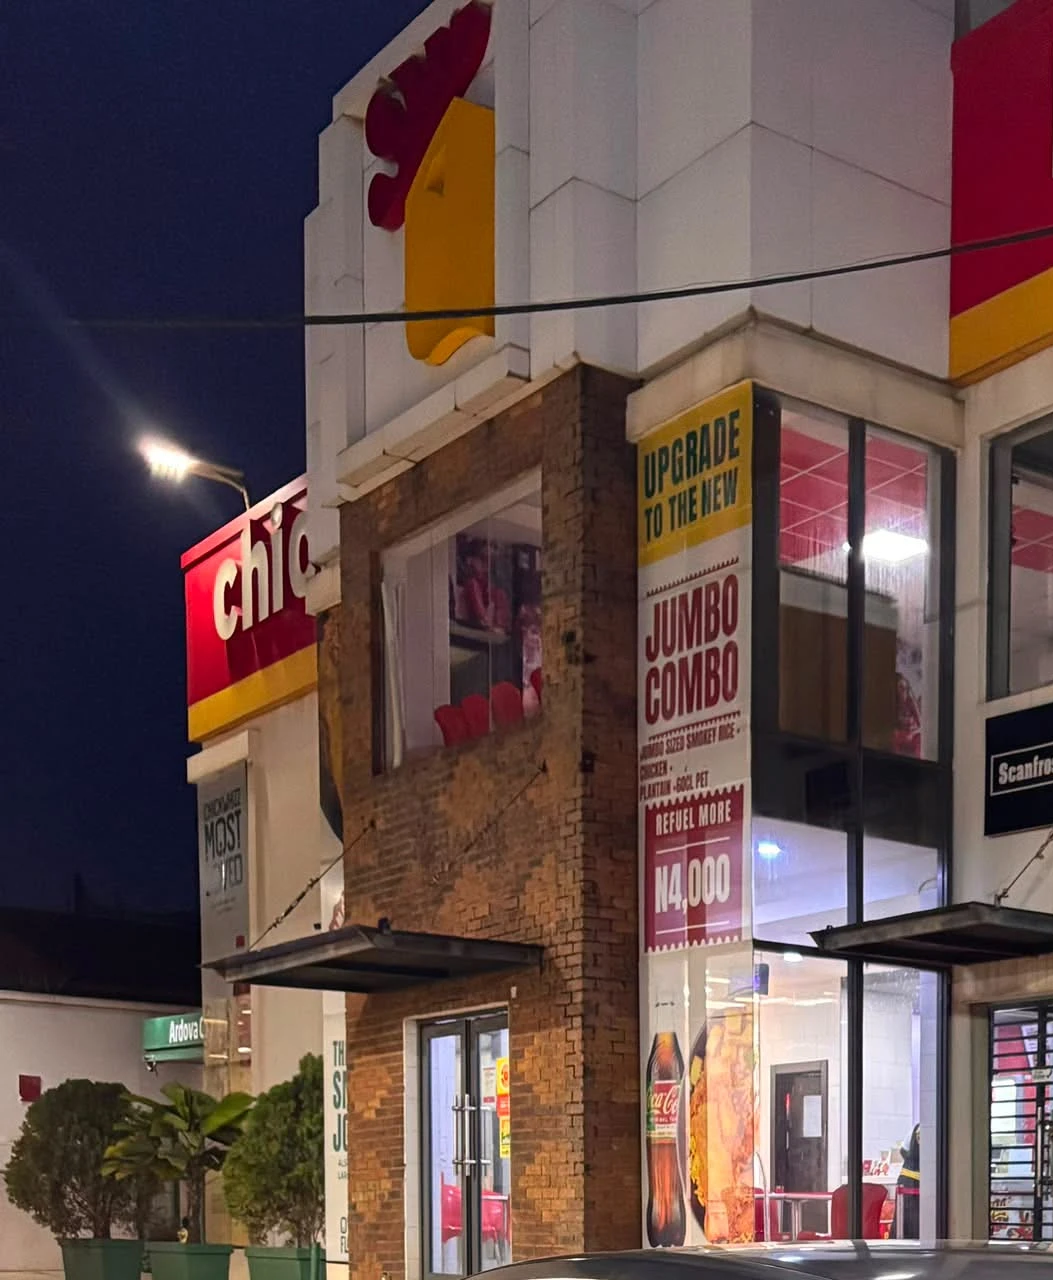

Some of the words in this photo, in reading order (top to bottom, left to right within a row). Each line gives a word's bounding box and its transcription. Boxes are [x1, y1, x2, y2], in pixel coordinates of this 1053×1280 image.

[643, 408, 741, 499] UPGRADE
[644, 500, 663, 543] TO
[668, 485, 697, 534] THE
[701, 466, 739, 519] NEW
[645, 572, 739, 664] JUMBO
[644, 639, 739, 725] COMBO
[695, 770, 709, 789] PET
[204, 806, 242, 863] MOST
[655, 807, 695, 837] REFUEL
[699, 799, 732, 827] MORE
[168, 1017, 199, 1044] Ardova
